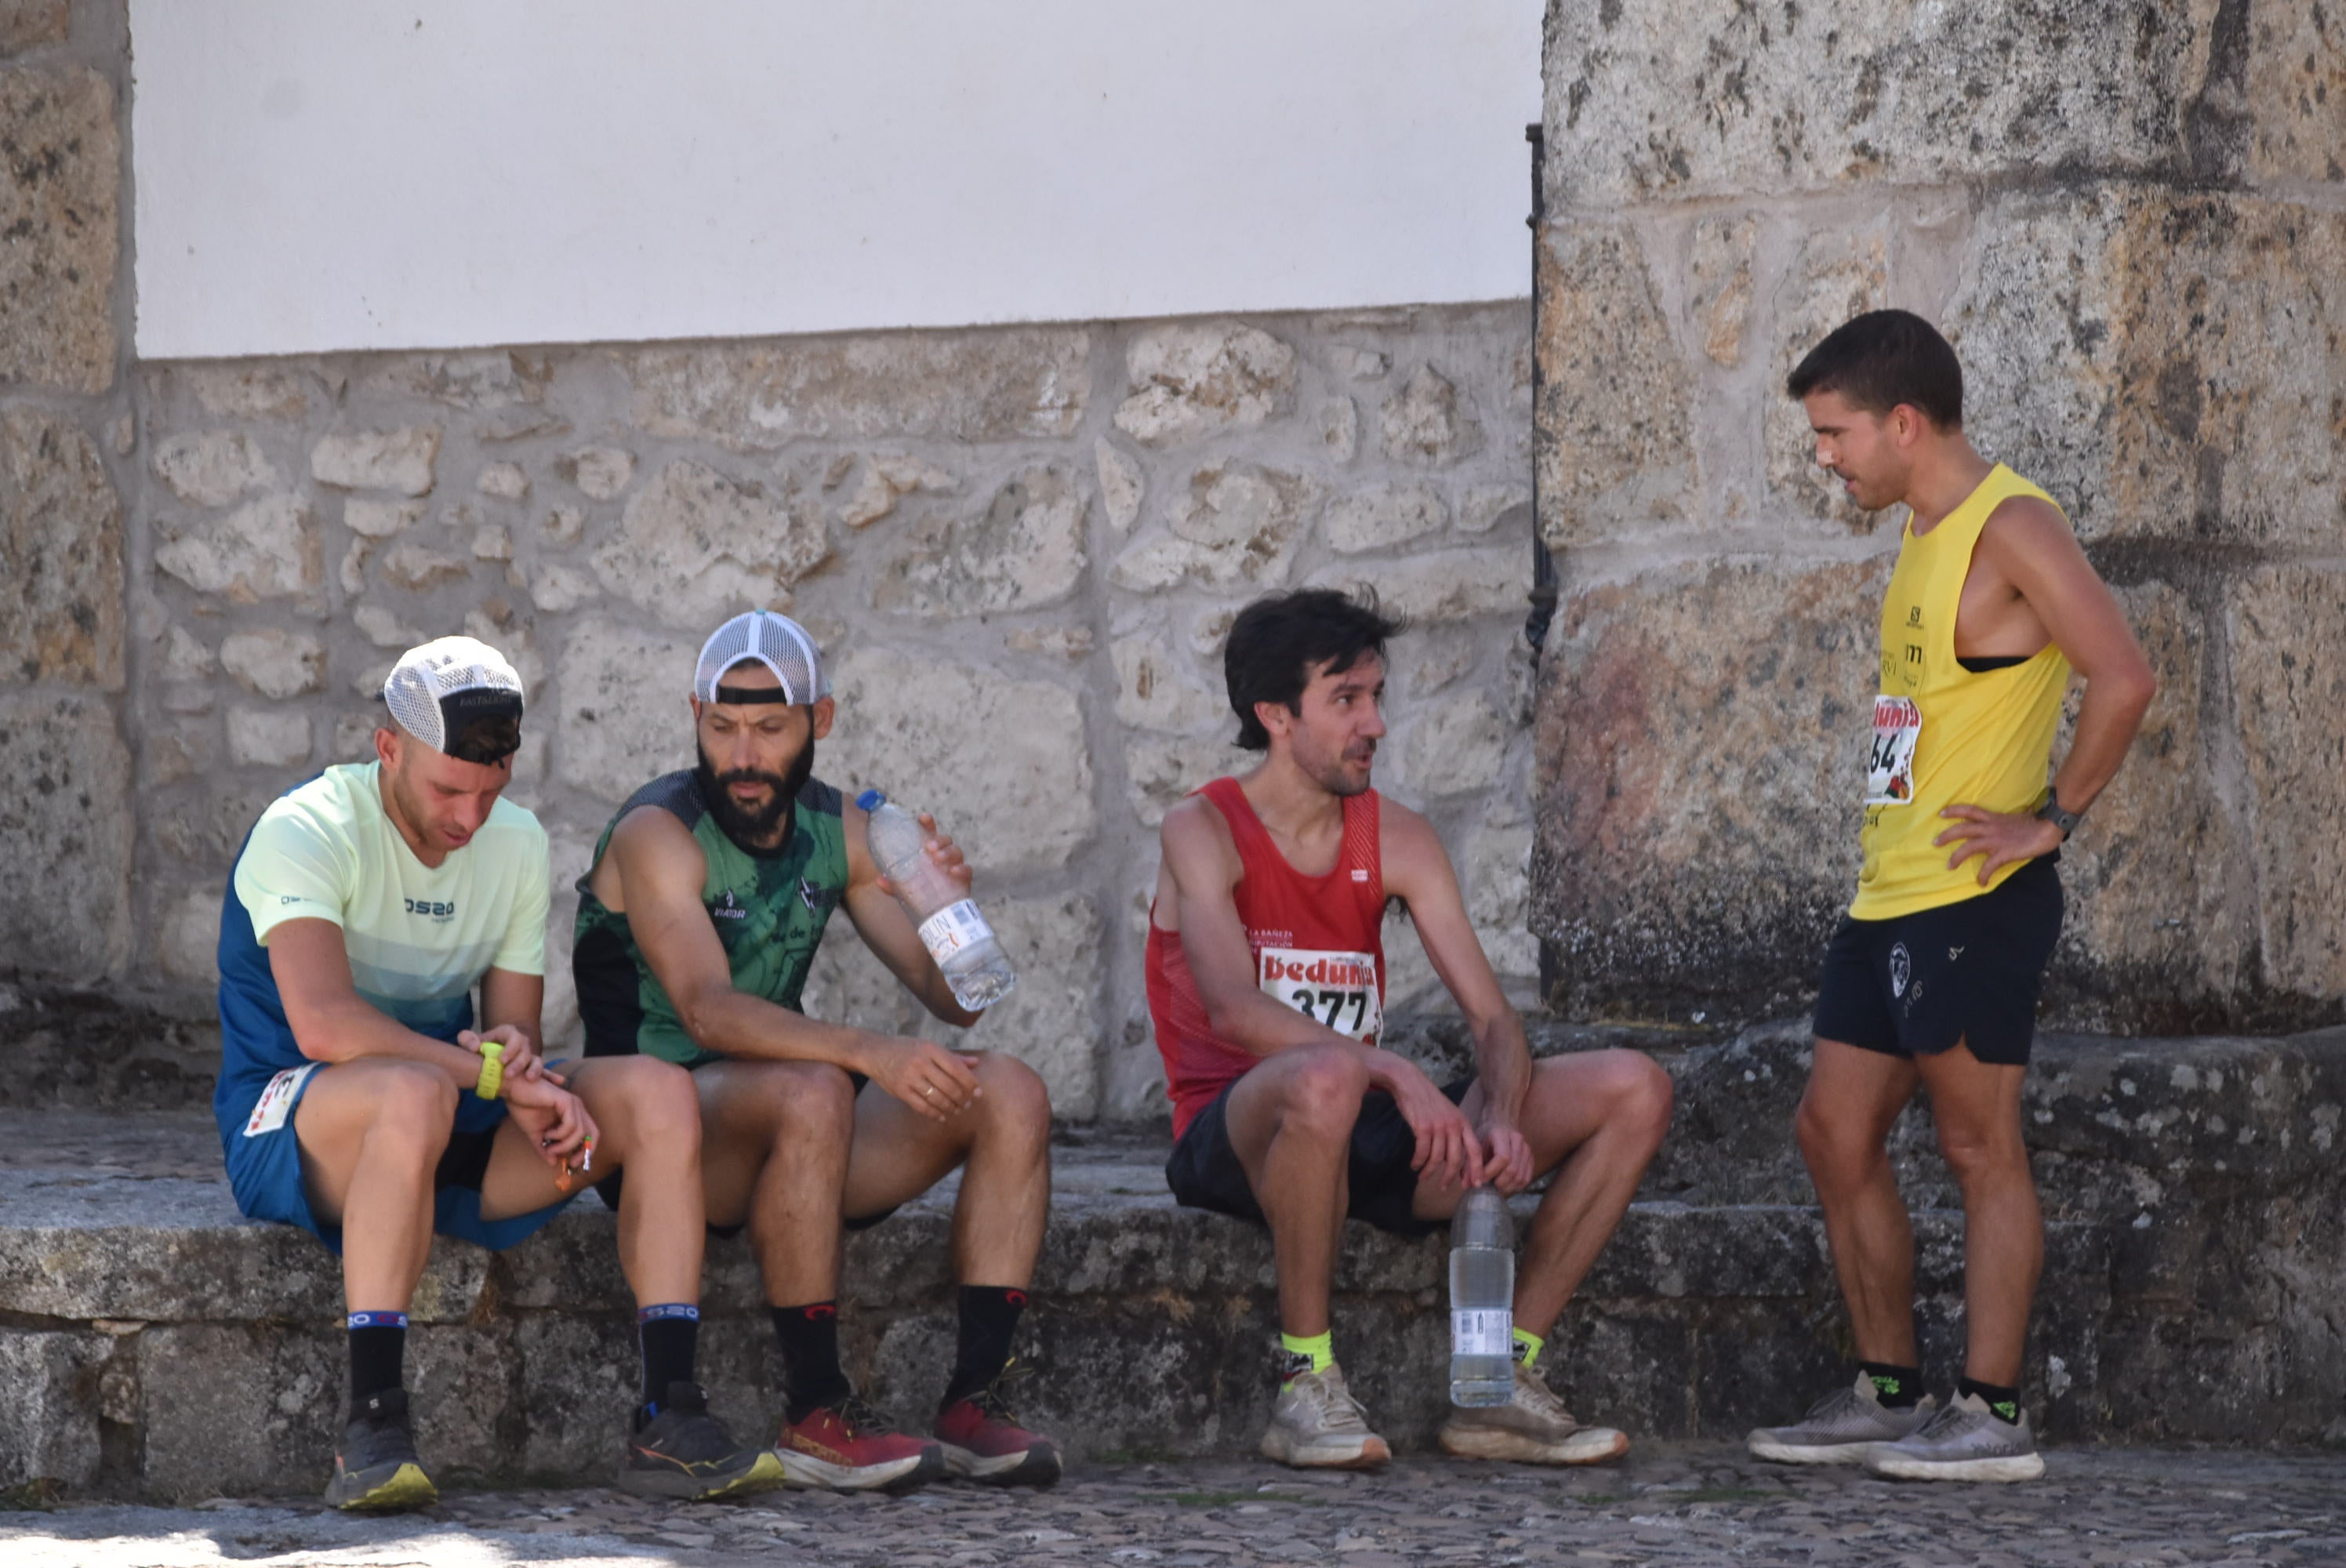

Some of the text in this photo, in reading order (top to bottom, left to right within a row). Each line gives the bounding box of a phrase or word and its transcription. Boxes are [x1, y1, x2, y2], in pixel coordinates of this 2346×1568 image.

[1873, 702, 1920, 728] unia
[714, 907, 746, 919] VIATOR
[1291, 989, 1367, 1031] 377
